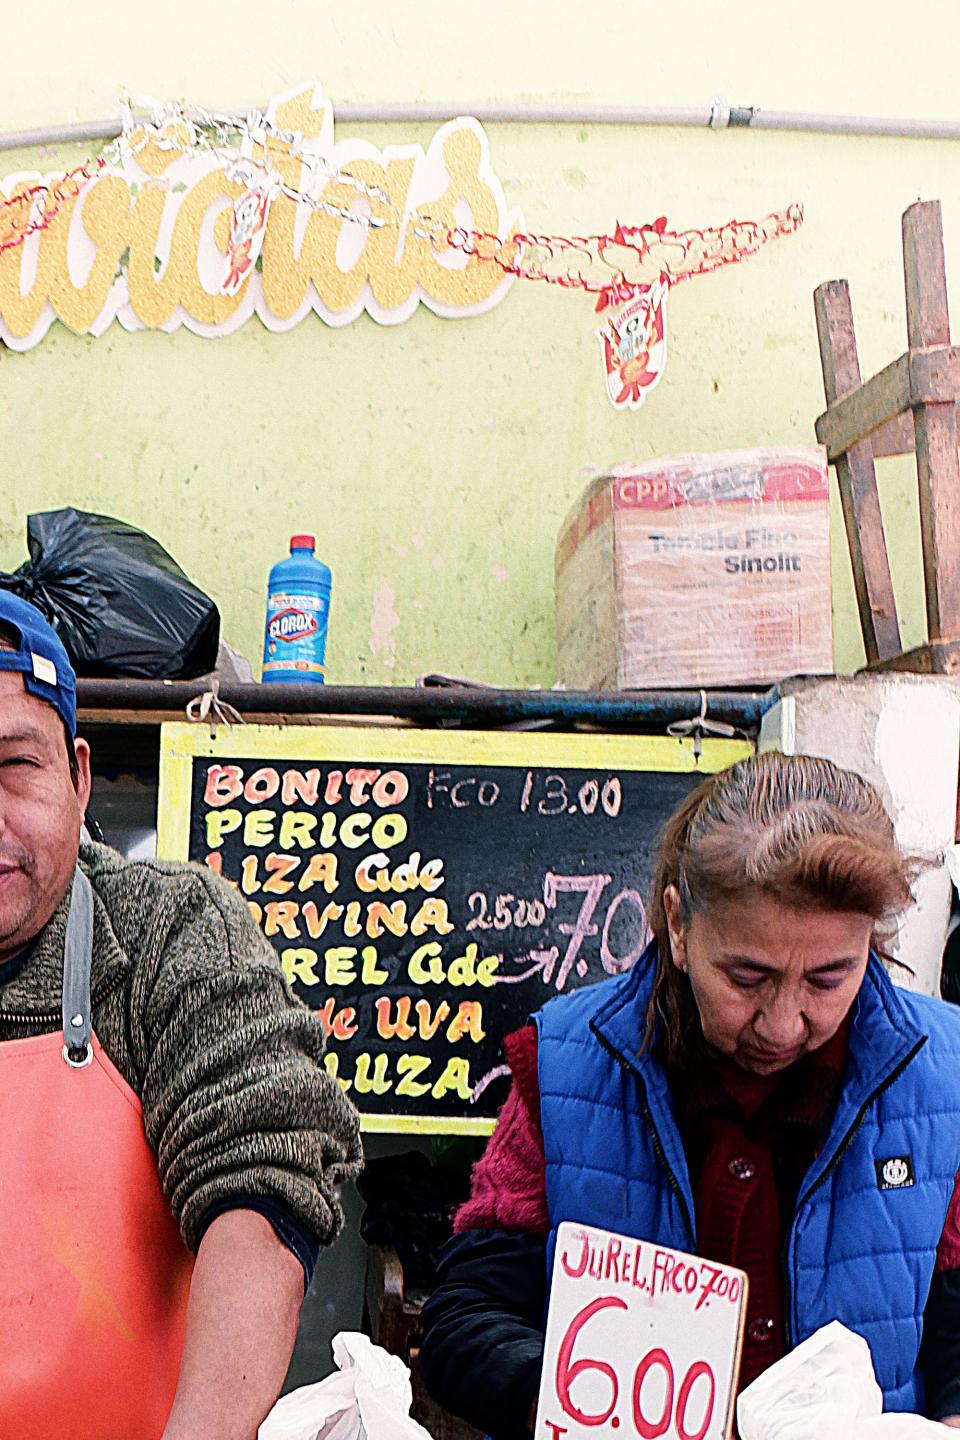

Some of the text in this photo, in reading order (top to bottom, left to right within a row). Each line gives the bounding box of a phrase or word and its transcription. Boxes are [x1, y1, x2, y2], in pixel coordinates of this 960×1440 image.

[619, 478, 671, 503] CPP
[724, 551, 801, 574] Sinolit
[270, 613, 313, 638] CLOROX
[203, 764, 409, 808] BONITO
[520, 770, 622, 818] 13.00
[204, 808, 408, 850] PERICO
[354, 851, 445, 894] Gde
[246, 898, 455, 939] RVINA
[544, 871, 655, 991] 7.0
[281, 941, 501, 988] REL Gde
[375, 996, 486, 1043] UVA
[324, 1052, 475, 1099] LUZA
